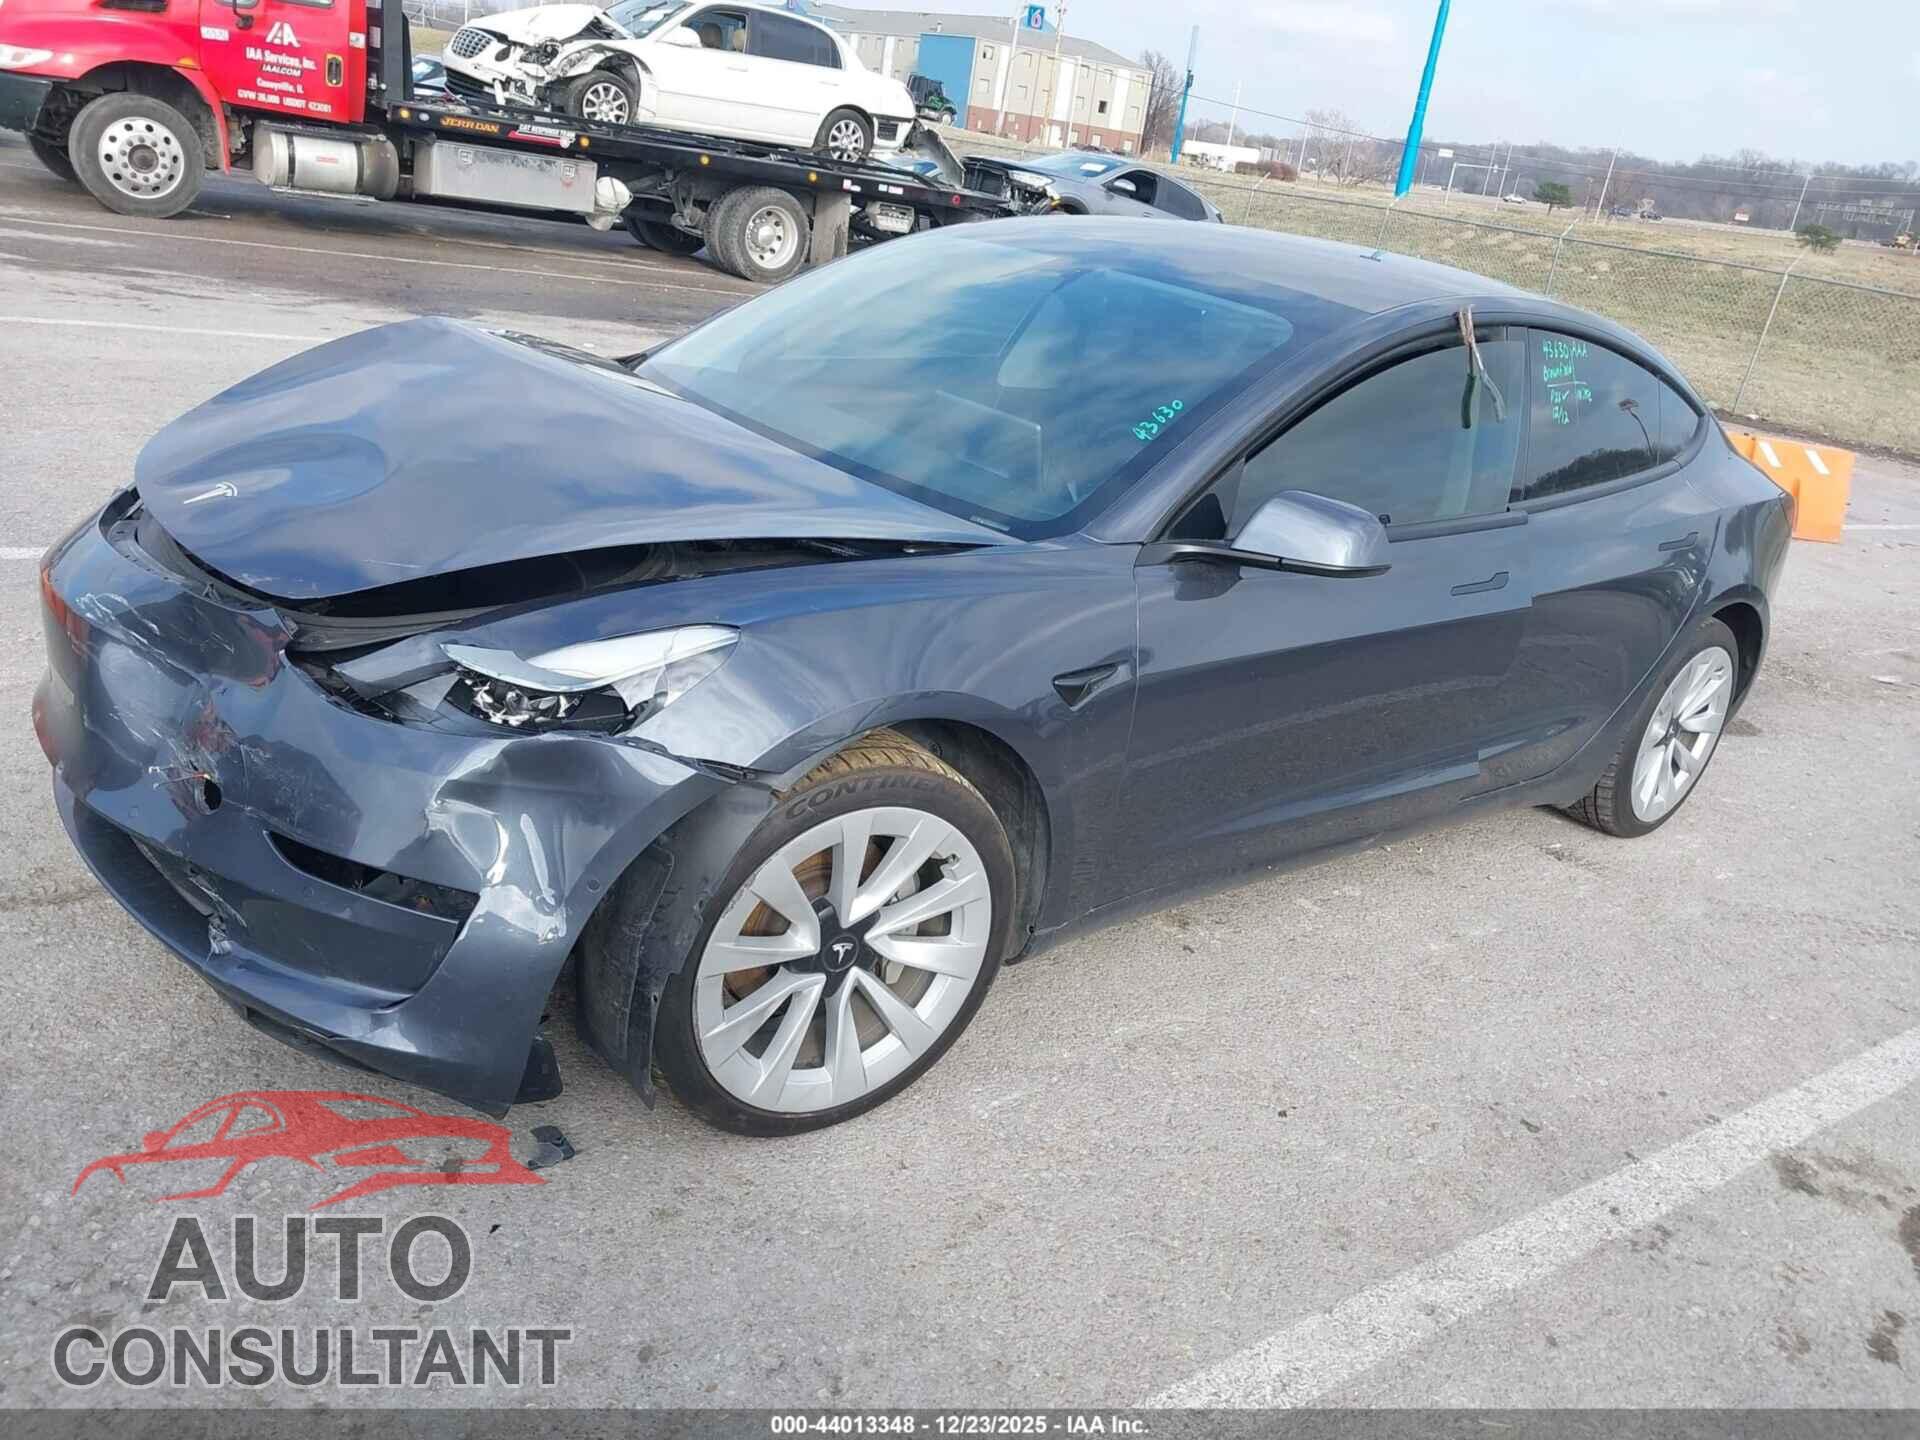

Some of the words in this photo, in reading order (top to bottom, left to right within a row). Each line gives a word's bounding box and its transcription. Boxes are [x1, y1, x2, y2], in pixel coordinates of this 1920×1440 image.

[246, 47, 263, 62] IAA
[263, 49, 303, 68] Services,
[1132, 399, 1184, 441] 43630
